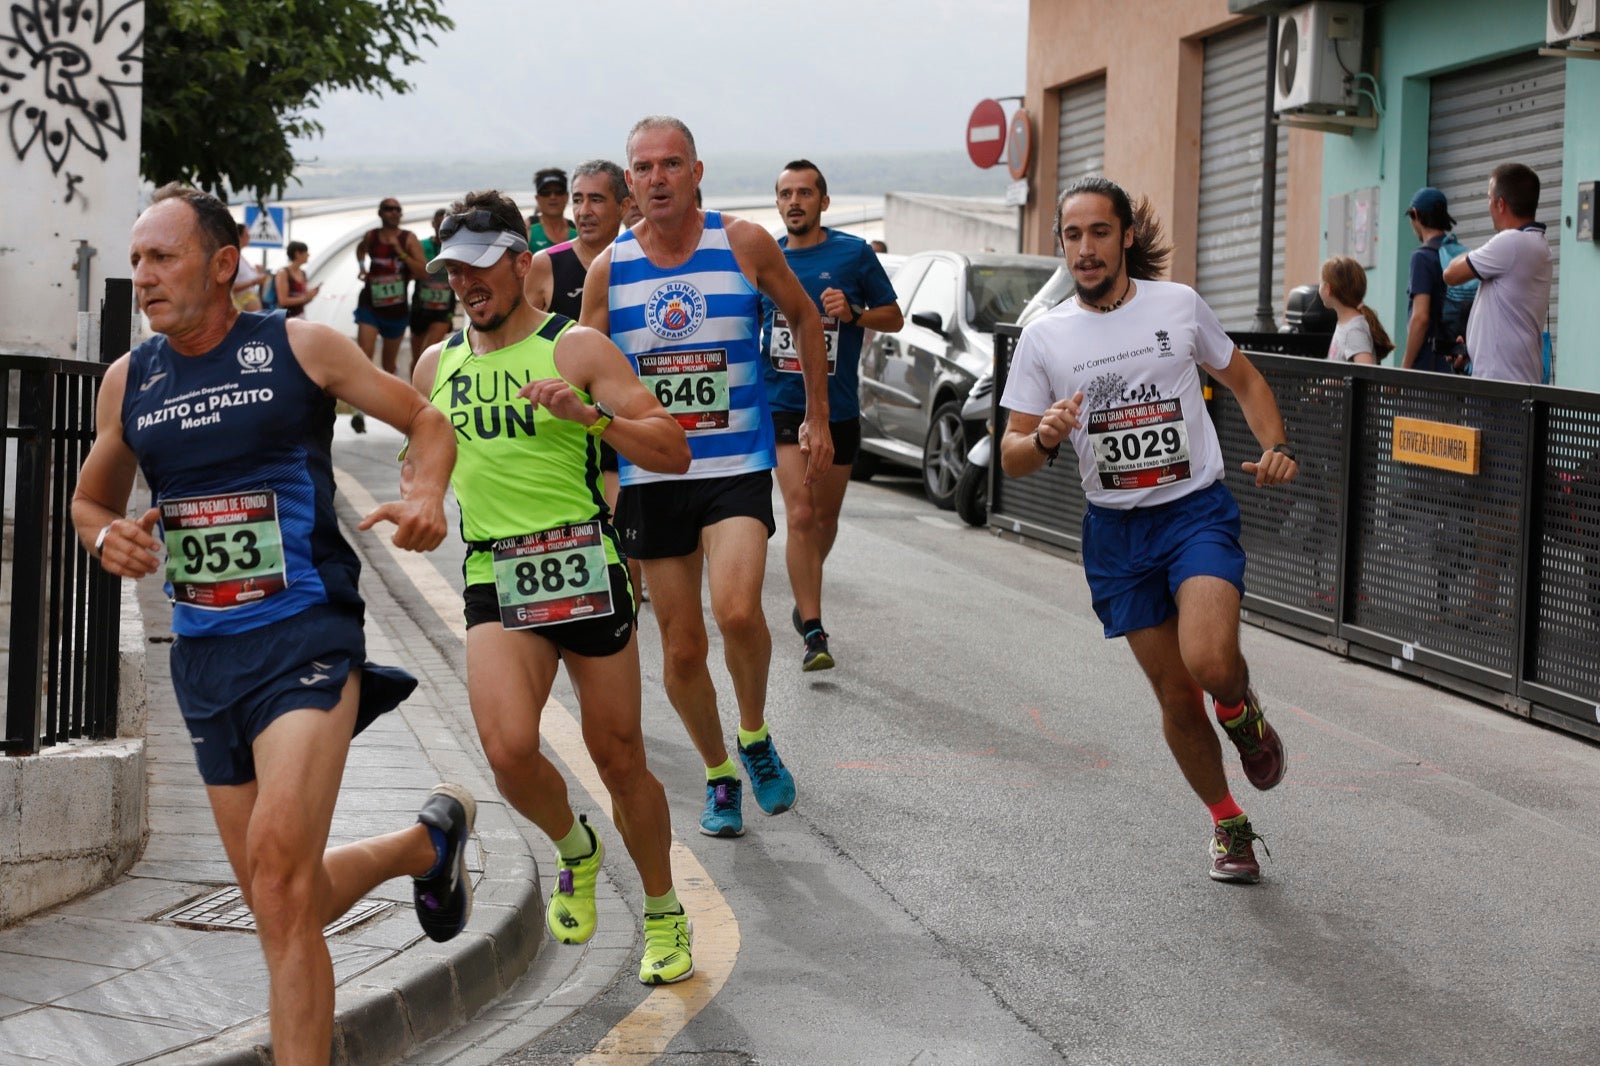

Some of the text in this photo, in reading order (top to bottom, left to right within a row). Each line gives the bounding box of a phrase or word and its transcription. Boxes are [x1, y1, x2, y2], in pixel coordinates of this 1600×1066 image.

[649, 284, 702, 325] PENYA RUNNERS
[656, 324, 697, 338] ESPANYOL
[244, 346, 266, 362] 30
[657, 357, 671, 366] GRAN
[672, 355, 694, 365] PREMIO
[695, 354, 702, 363] DE
[704, 353, 721, 363] FONDO
[1073, 364, 1085, 373] XIV
[1086, 356, 1116, 369] Carrera
[1116, 350, 1130, 361] del
[201, 382, 239, 395] Deportiva
[450, 370, 530, 409] RUN
[655, 377, 715, 407] 646
[137, 388, 273, 431] PAZITO a PAZITO
[181, 412, 221, 430] Motril
[1107, 412, 1124, 422] GRAN
[1125, 407, 1148, 420] PREMIO
[1148, 405, 1156, 415] DE
[1157, 402, 1176, 414] FONDO
[451, 405, 536, 444] RUN
[1102, 427, 1181, 463] 3029
[1399, 430, 1467, 462] CERVEZAS ALHAMBRA
[179, 502, 198, 516] GRAN
[199, 499, 228, 514] PREMIO
[229, 498, 239, 510] DE
[240, 494, 267, 509] FONDO
[571, 524, 594, 537] FONDO
[182, 530, 261, 574] 953
[515, 553, 590, 596] 883
